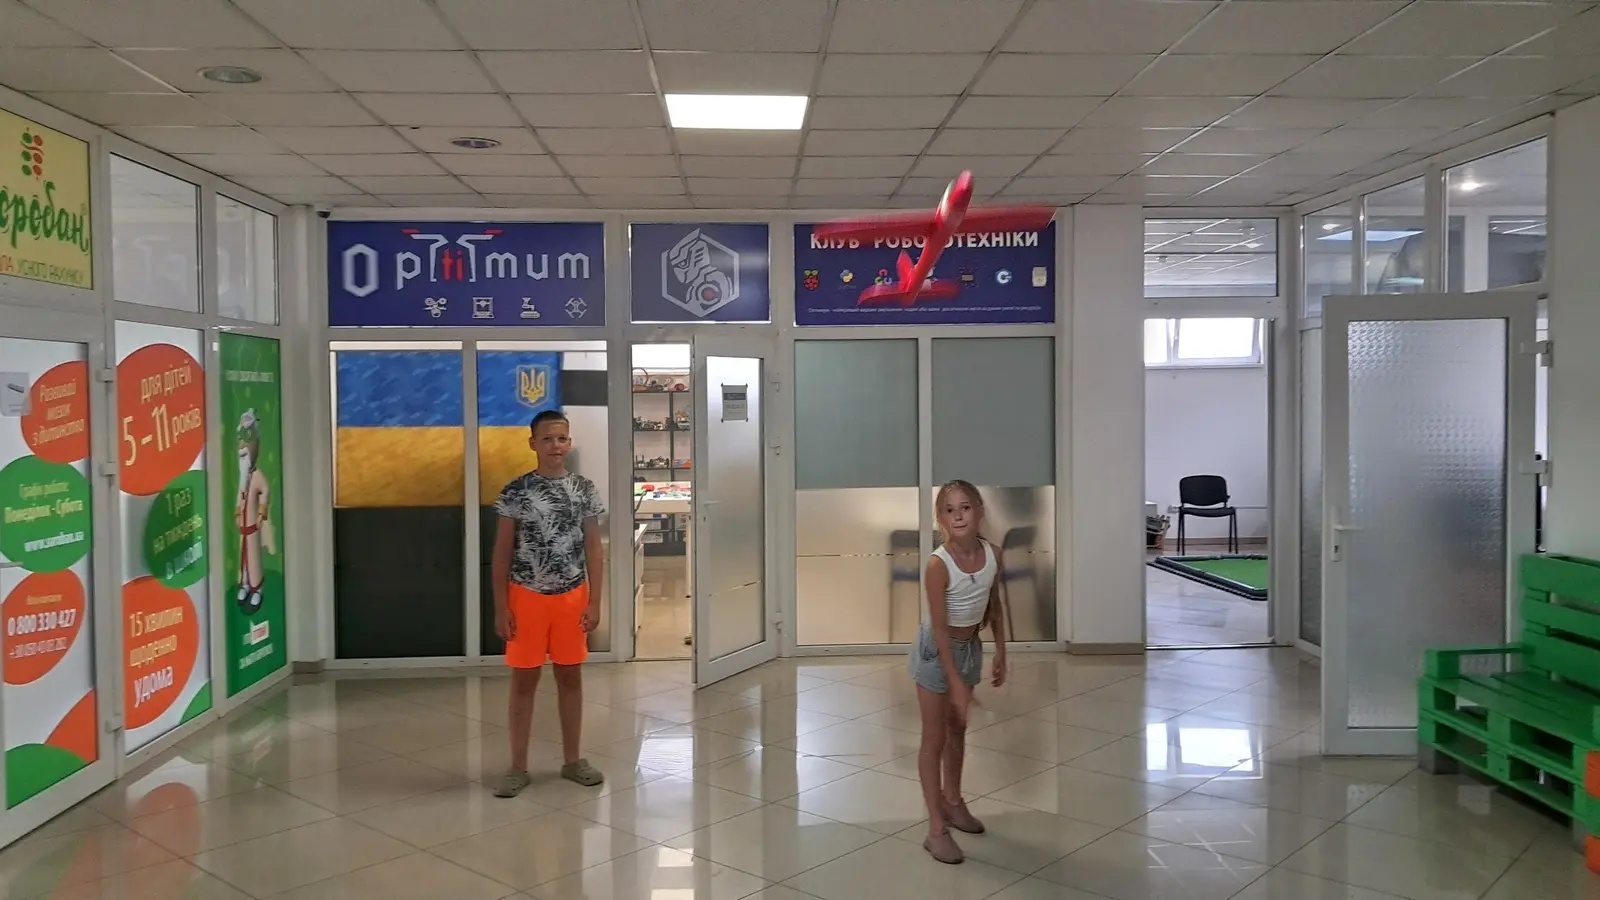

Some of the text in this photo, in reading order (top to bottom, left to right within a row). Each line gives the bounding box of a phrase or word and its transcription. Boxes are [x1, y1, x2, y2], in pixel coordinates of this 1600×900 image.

[172, 403, 202, 444] років
[174, 487, 192, 517] раз
[8, 617, 16, 636] 0
[16, 614, 37, 635] 800
[37, 611, 58, 632] 330
[129, 611, 144, 638] 15
[134, 666, 173, 708] удома
